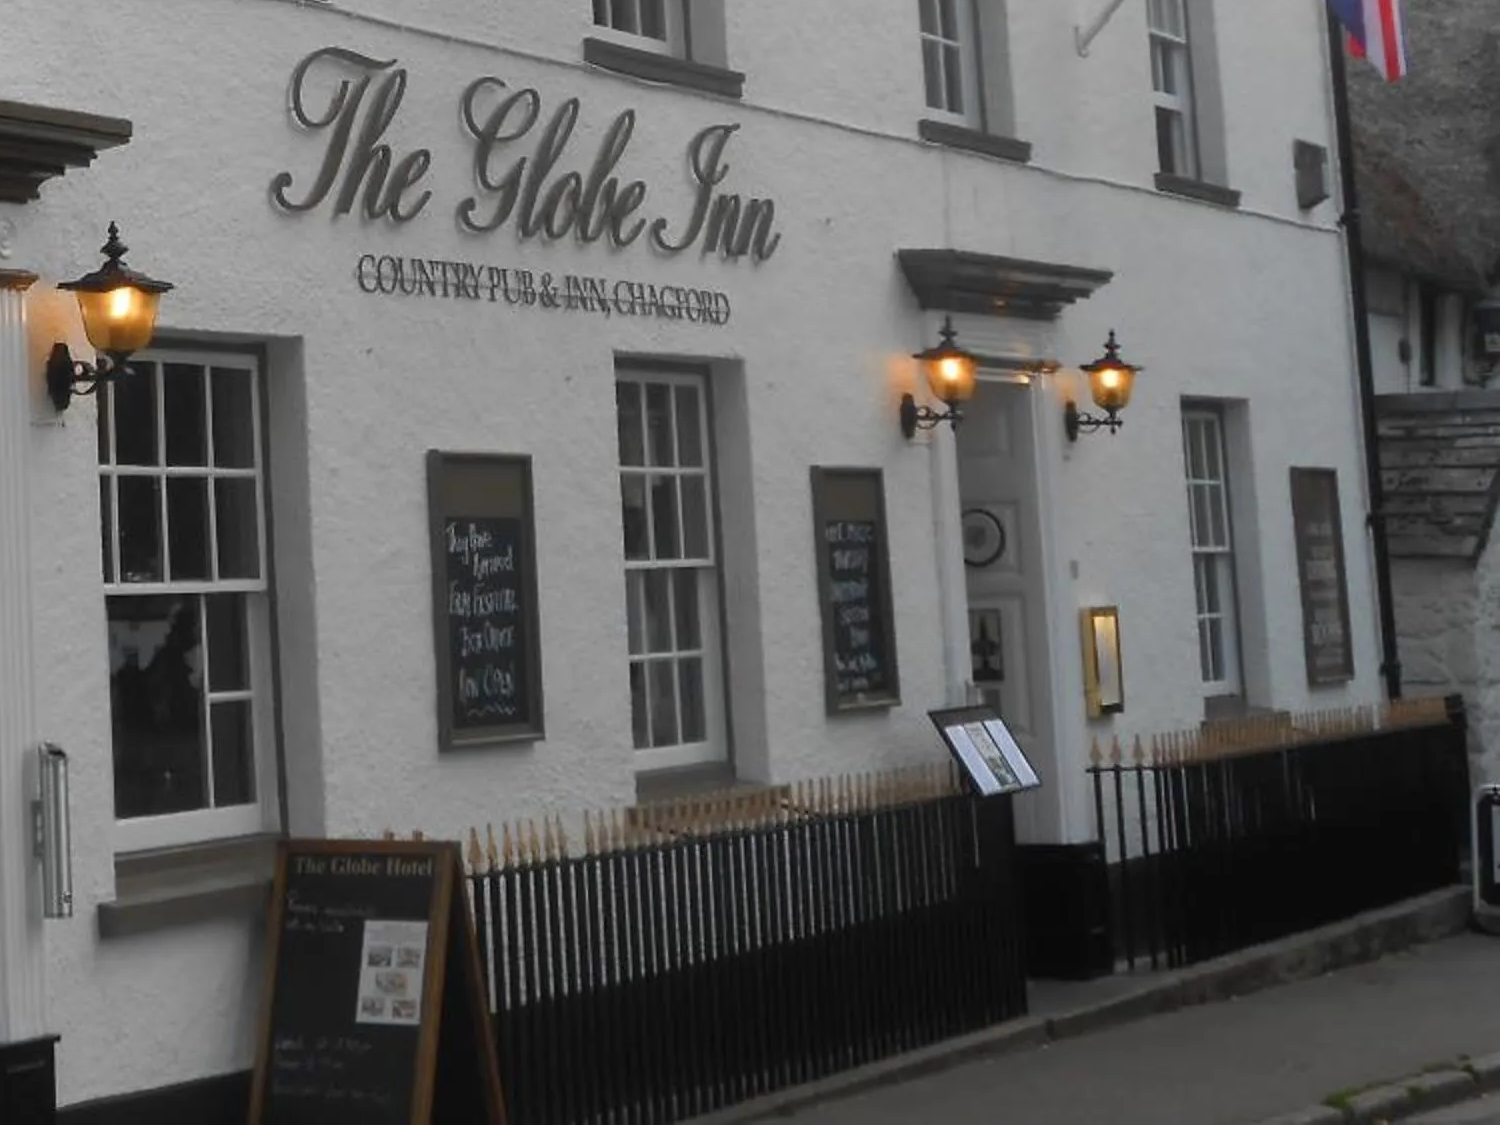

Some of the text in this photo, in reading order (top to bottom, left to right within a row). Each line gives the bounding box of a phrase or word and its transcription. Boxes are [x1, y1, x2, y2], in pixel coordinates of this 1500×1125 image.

[269, 46, 781, 262] The Globe Inn
[356, 255, 484, 300] COUNTRY
[488, 266, 536, 305] PUB
[539, 272, 560, 308] &
[613, 281, 730, 324] CHAGFORD
[295, 856, 432, 876] The Globe Hotel
